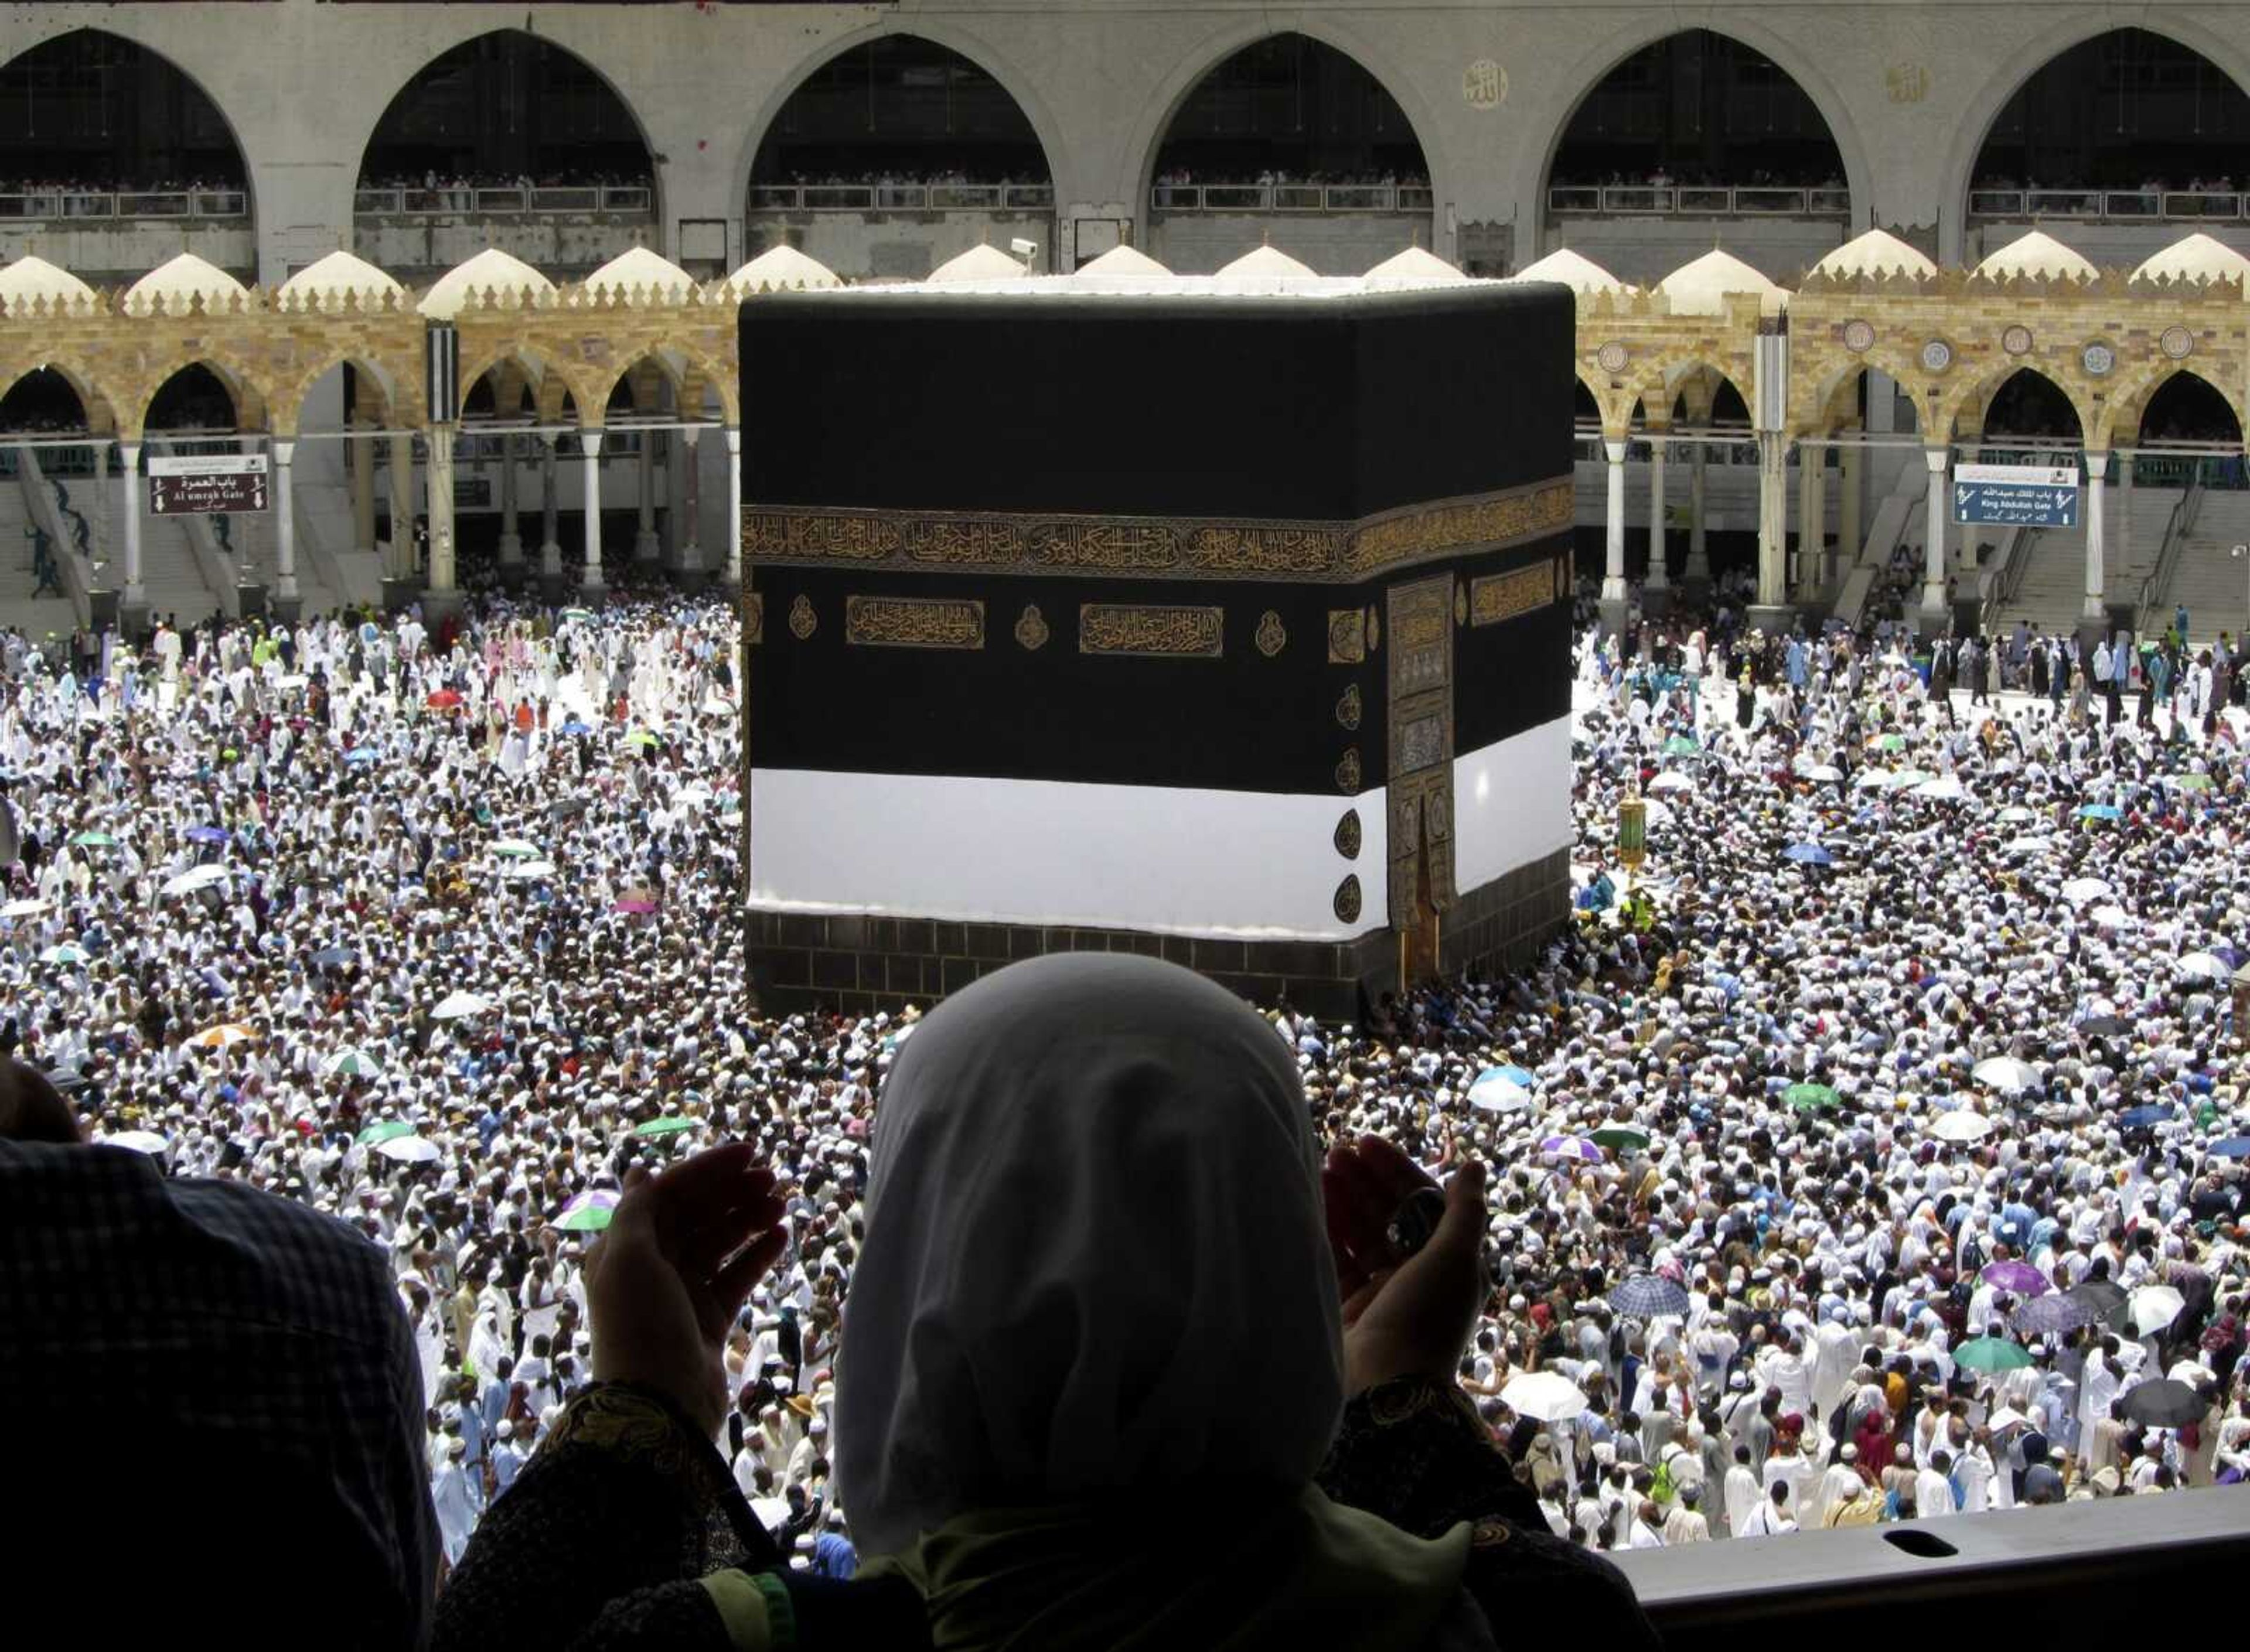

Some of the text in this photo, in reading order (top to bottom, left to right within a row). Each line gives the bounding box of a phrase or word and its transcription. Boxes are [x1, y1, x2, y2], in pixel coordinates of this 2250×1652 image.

[218, 476, 237, 490] باب
[1982, 499, 2051, 510] King Abdullah Gate
